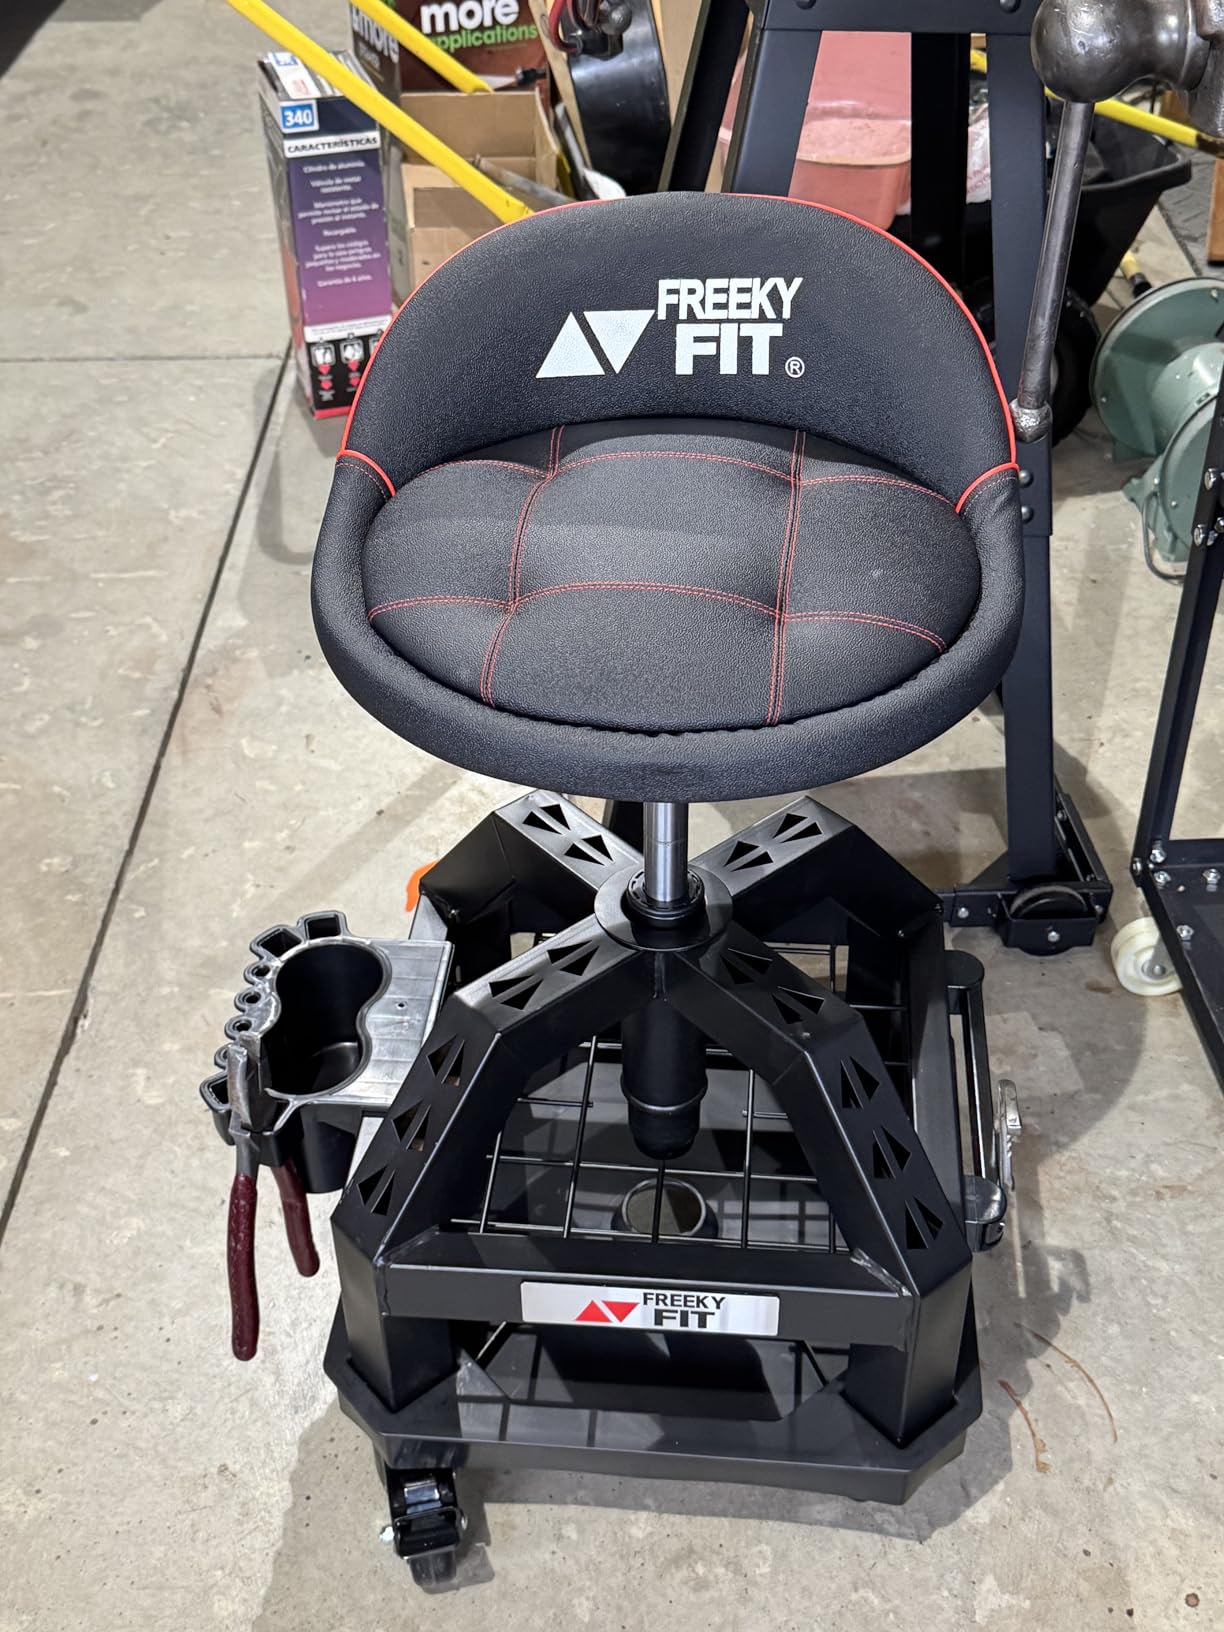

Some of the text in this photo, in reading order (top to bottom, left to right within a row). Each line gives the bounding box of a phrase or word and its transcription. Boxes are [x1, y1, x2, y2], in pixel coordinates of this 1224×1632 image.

[420, 0, 519, 34] more
[433, 24, 538, 53] pplications
[284, 108, 313, 127] 340
[658, 277, 803, 320] FREEKY
[675, 322, 783, 375] FIT
[643, 1292, 726, 1310] FREEKY
[654, 1308, 715, 1329] FIT
